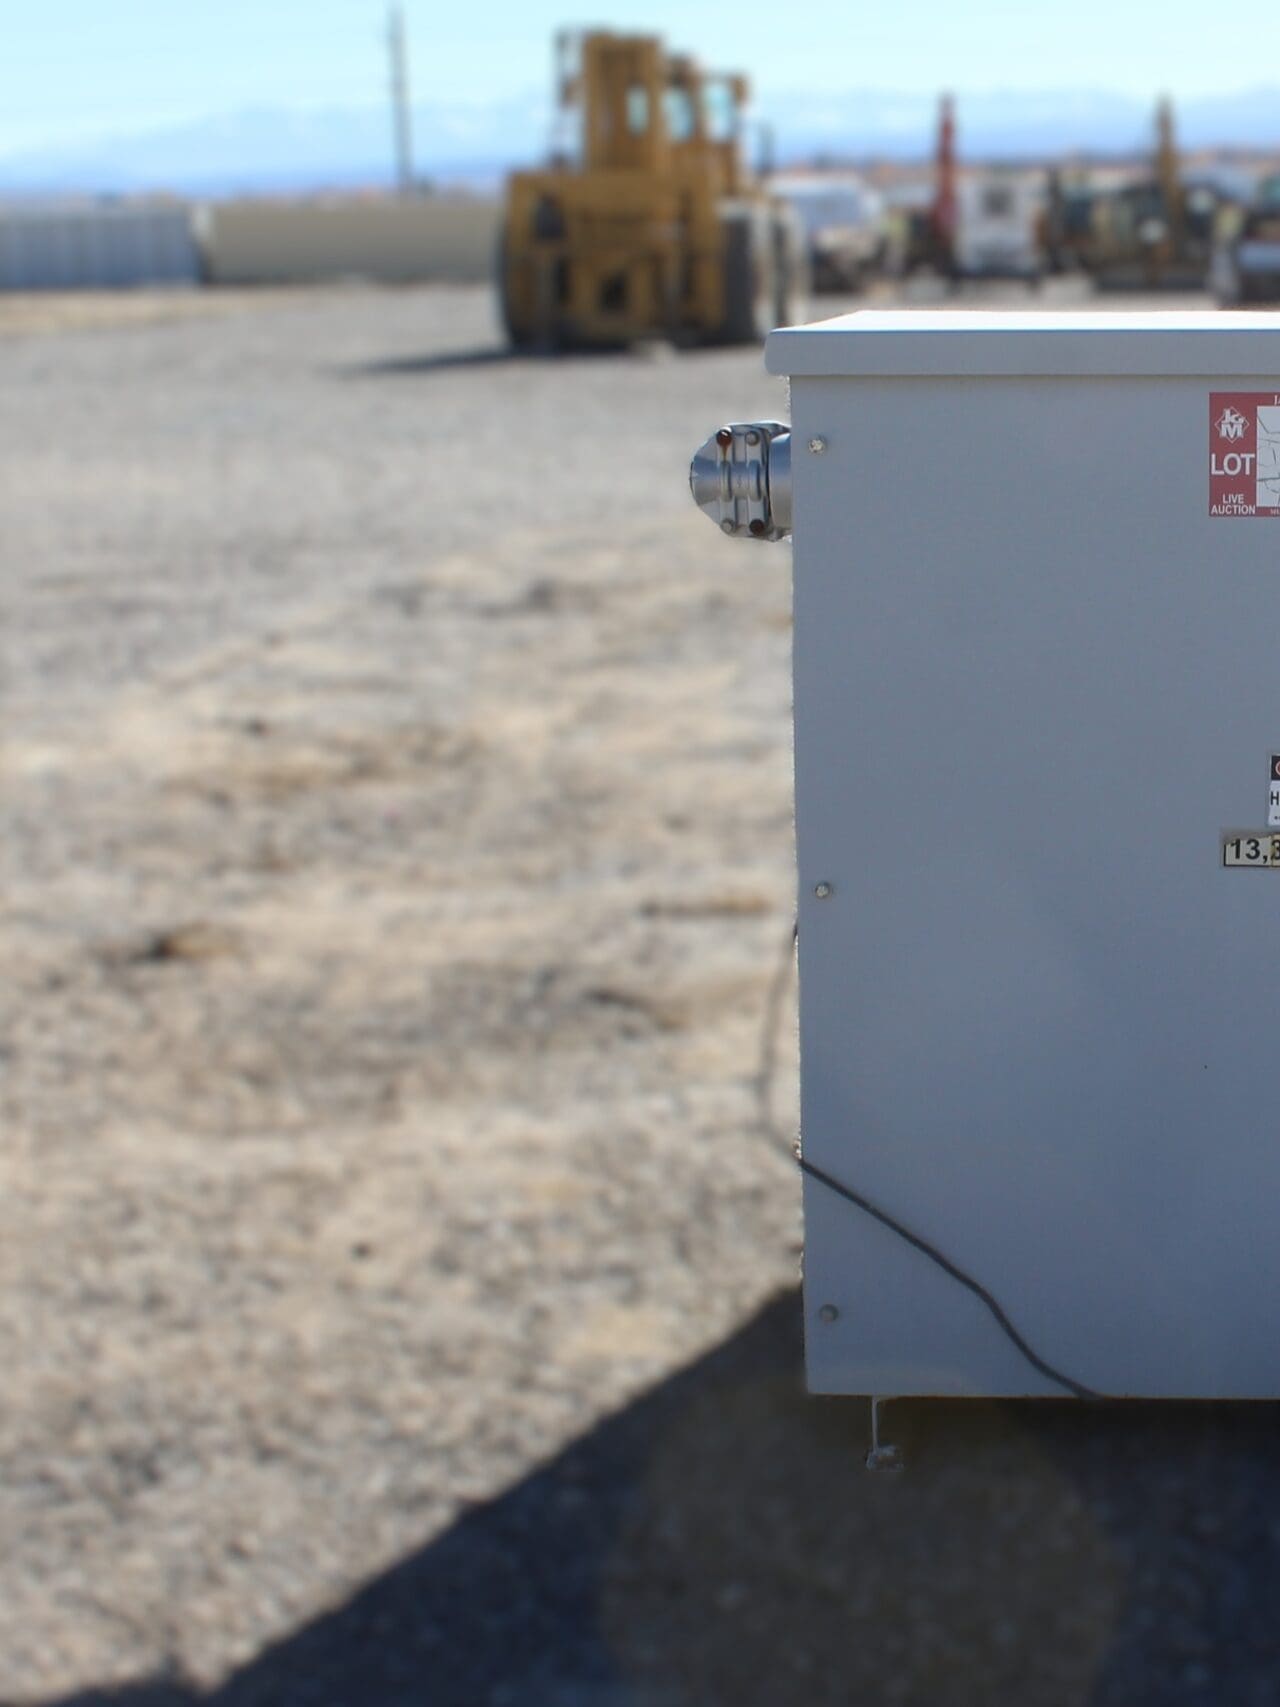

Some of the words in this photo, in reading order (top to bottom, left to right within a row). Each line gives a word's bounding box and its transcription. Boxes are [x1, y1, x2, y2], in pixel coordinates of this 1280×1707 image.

[1210, 453, 1255, 476] LOT
[1222, 494, 1244, 504] LIVE
[1210, 504, 1256, 515] AUCTION
